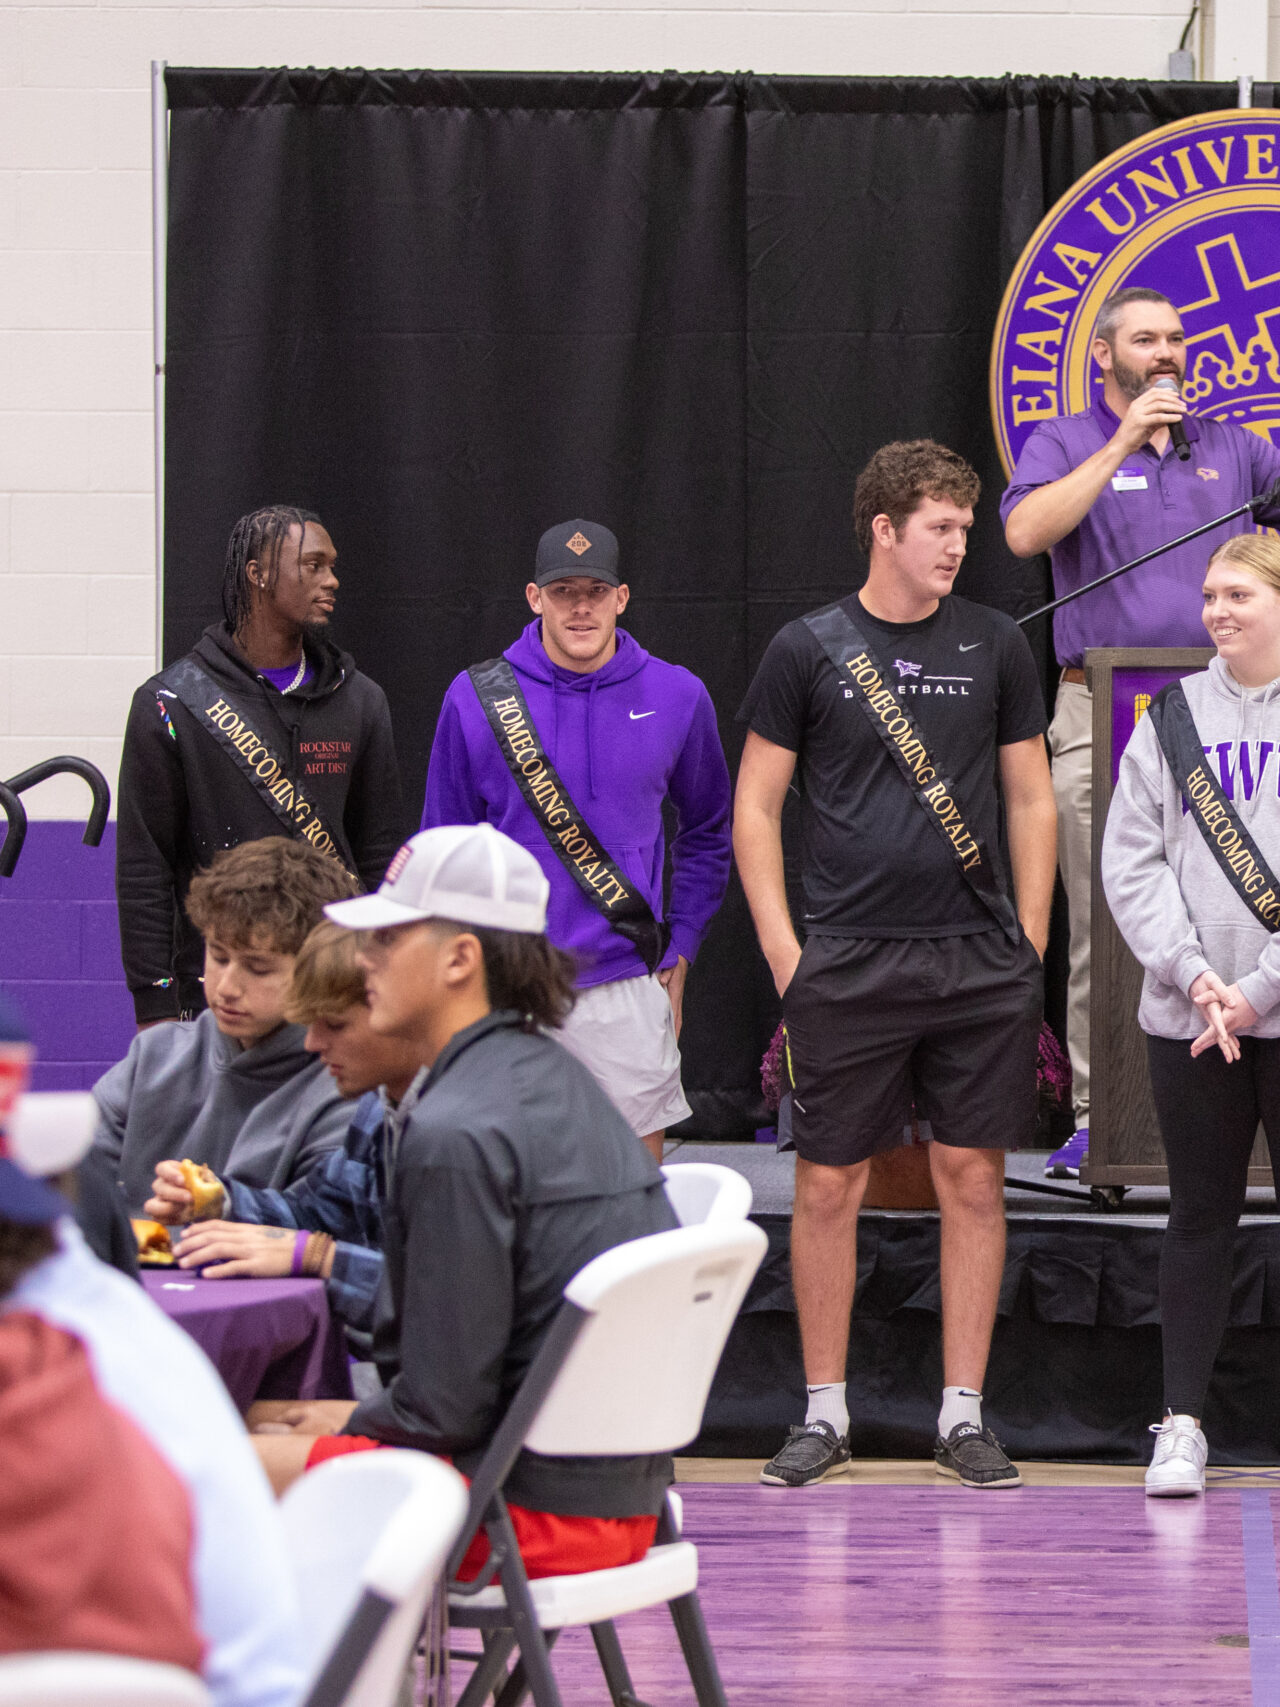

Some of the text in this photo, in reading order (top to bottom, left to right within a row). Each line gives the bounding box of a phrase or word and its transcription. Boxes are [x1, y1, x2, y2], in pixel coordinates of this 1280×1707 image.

[299, 741, 352, 754] ROCKSTAR
[844, 685, 969, 698] BETBALL
[205, 698, 311, 824] HOMECOMING
[304, 763, 326, 775] ART
[493, 695, 630, 909] HOMECOMING ROYALTY
[845, 652, 982, 873] HOMECOMING ROYALTY
[1187, 765, 1265, 893] HOMECOMING
